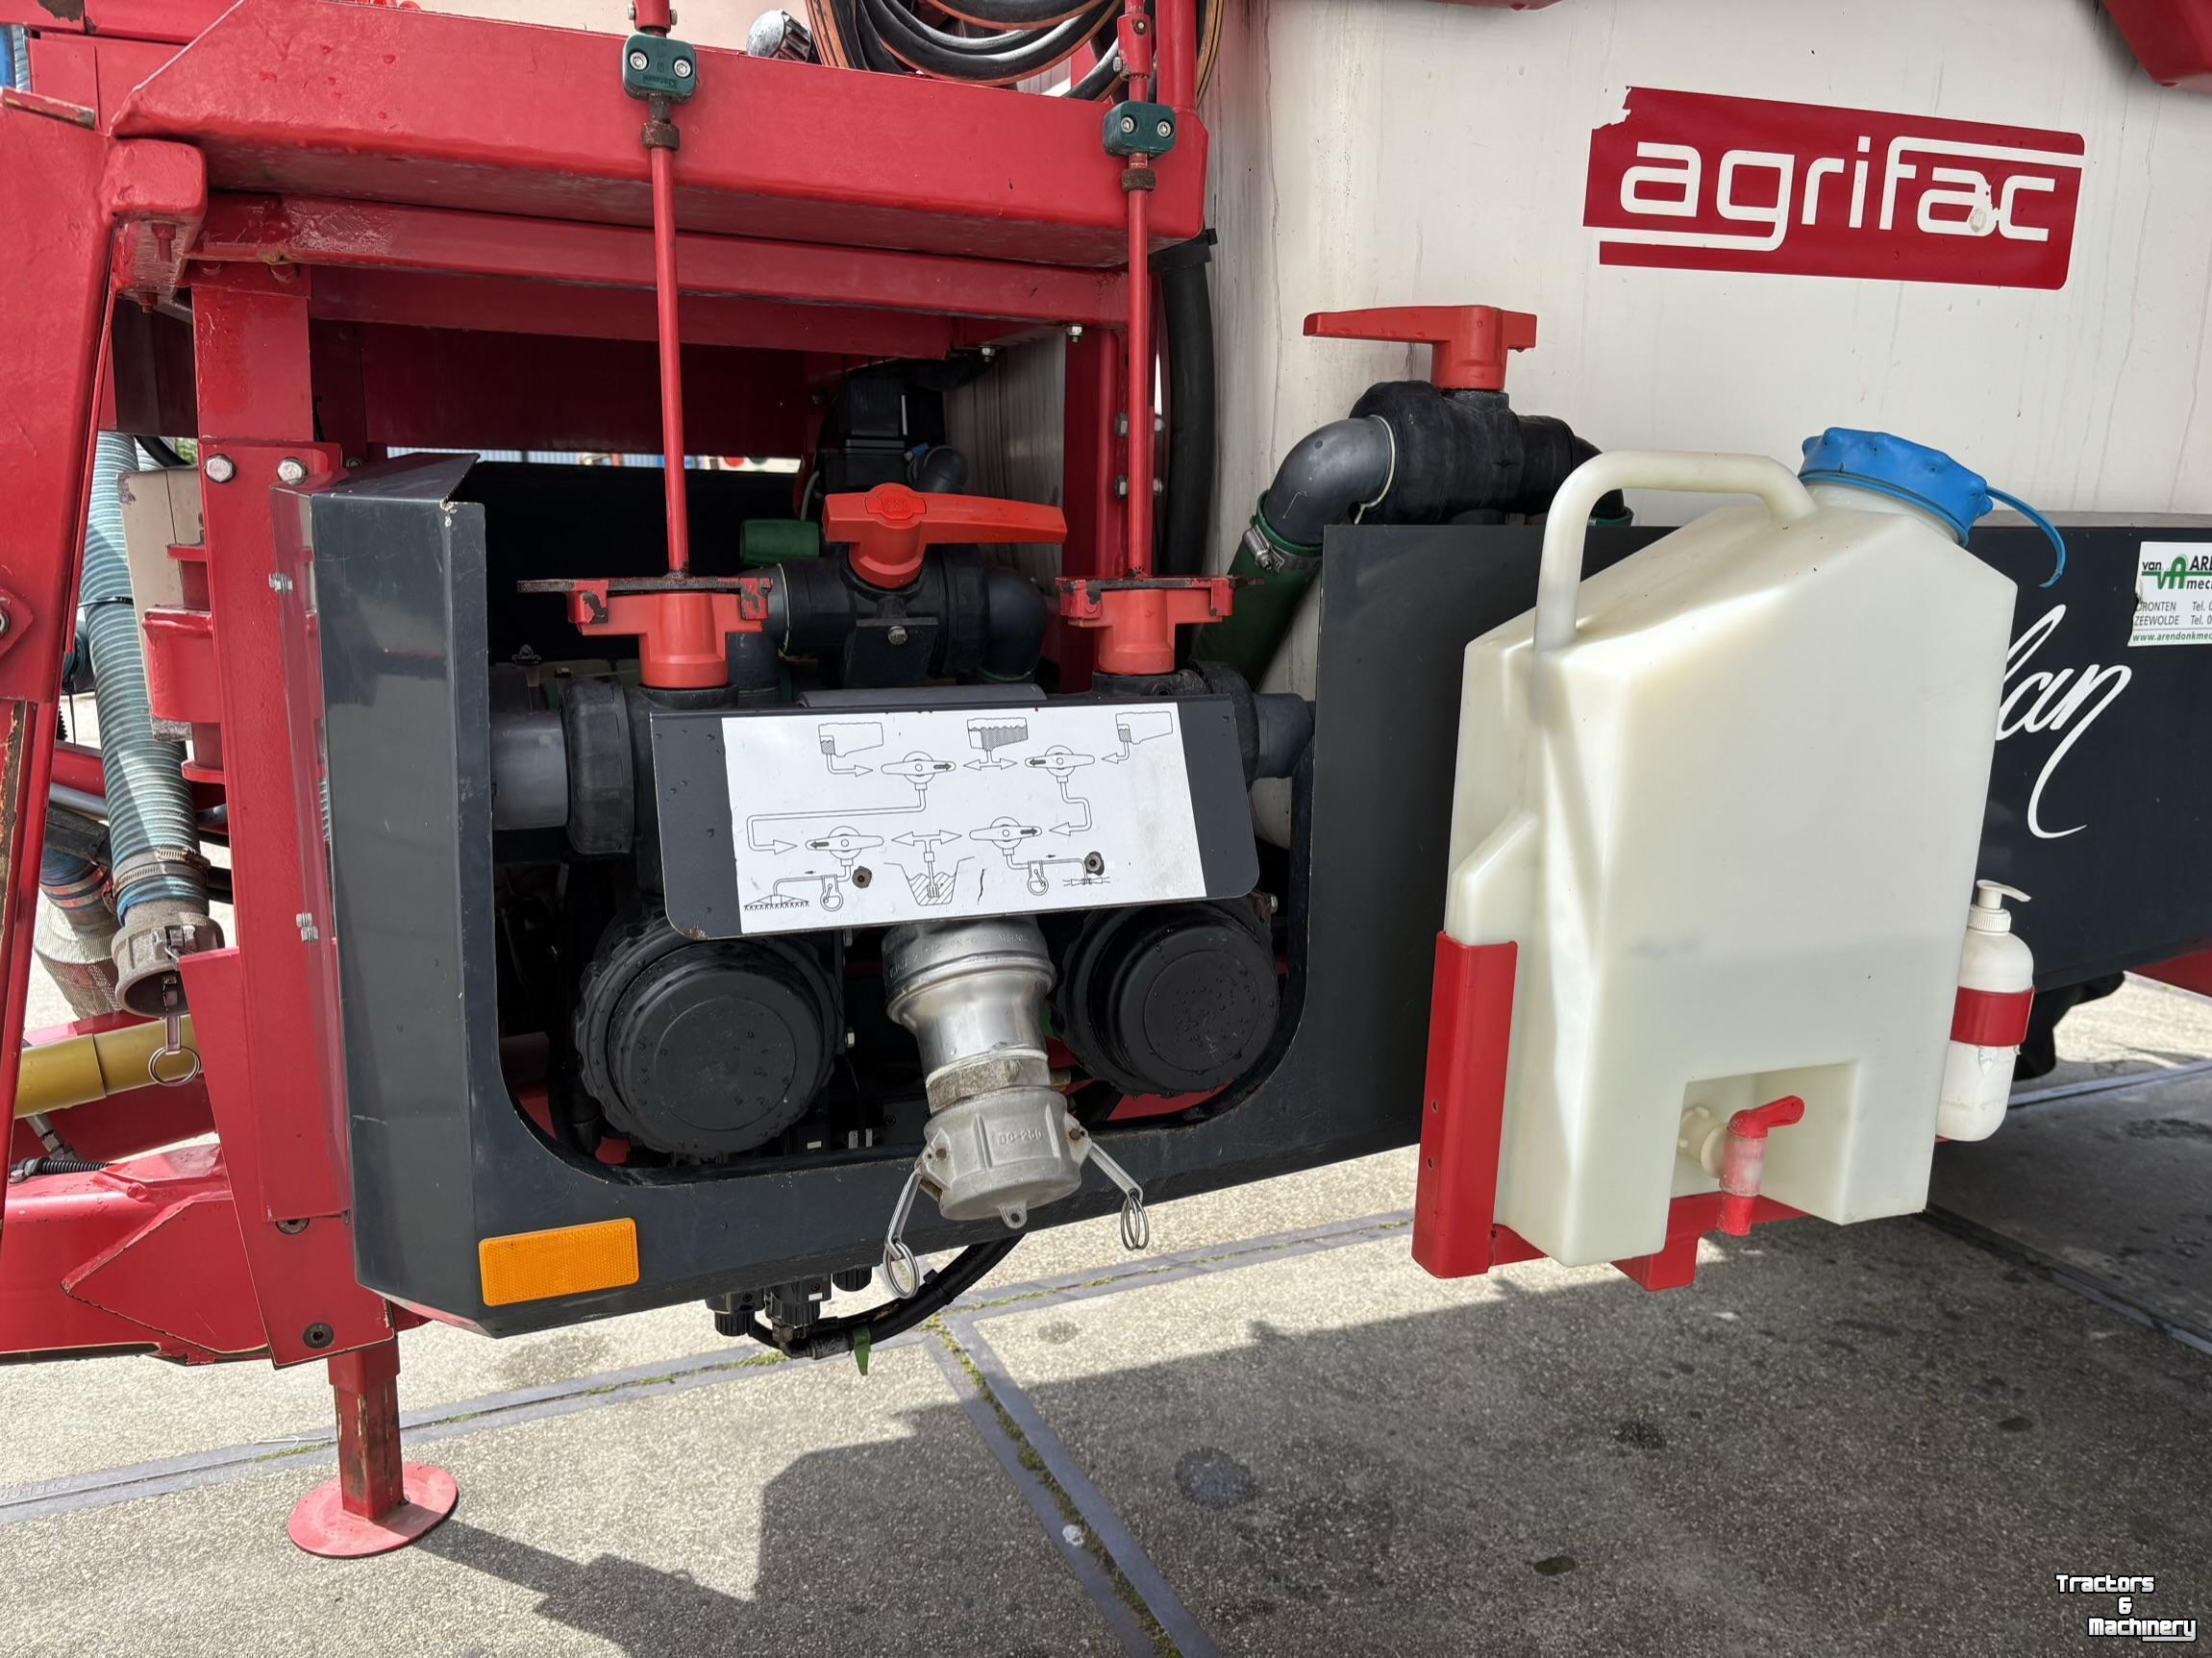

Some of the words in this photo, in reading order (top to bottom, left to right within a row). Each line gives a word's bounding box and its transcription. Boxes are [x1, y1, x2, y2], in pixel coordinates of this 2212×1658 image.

[1586, 135, 2084, 252] agrifac
[2141, 561, 2162, 571] van
[2186, 580, 2212, 590] mec
[2192, 601, 2205, 612] Tel.
[2133, 614, 2180, 627] ZEEWOLDE
[2190, 614, 2204, 626] Tel.
[1996, 604, 2132, 839] lan
